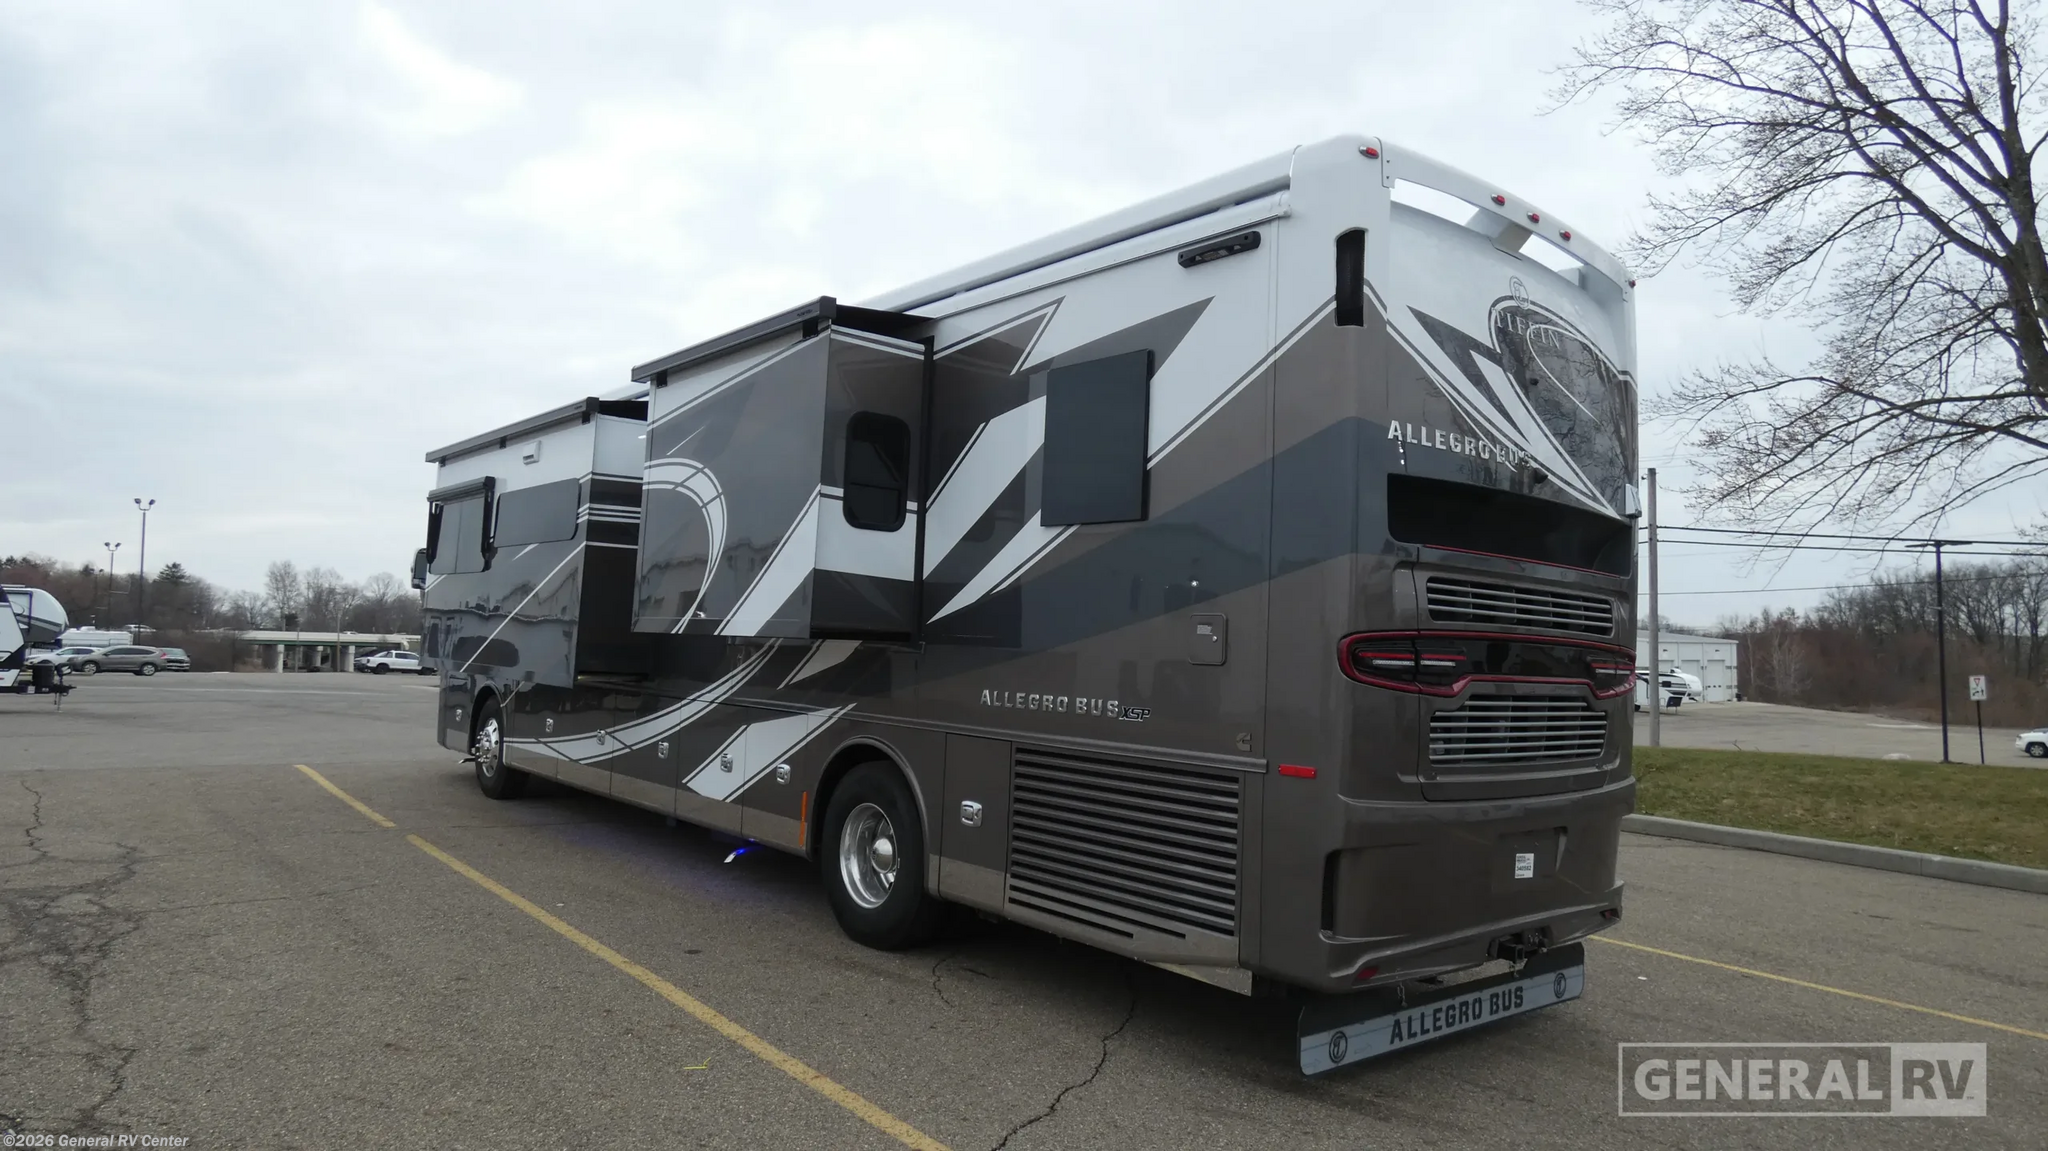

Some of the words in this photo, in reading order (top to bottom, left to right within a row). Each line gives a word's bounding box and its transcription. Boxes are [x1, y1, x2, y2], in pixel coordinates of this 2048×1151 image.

[1491, 307, 1560, 350] TIFFIN
[1387, 420, 1490, 460] ALLEGRO
[1496, 443, 1533, 467] BUS
[980, 689, 1068, 712] ALLEGRO
[1075, 697, 1119, 718] BUS
[1119, 706, 1151, 721] XSP
[1389, 997, 1482, 1045] ALLEGRO
[1489, 986, 1524, 1016] BUS
